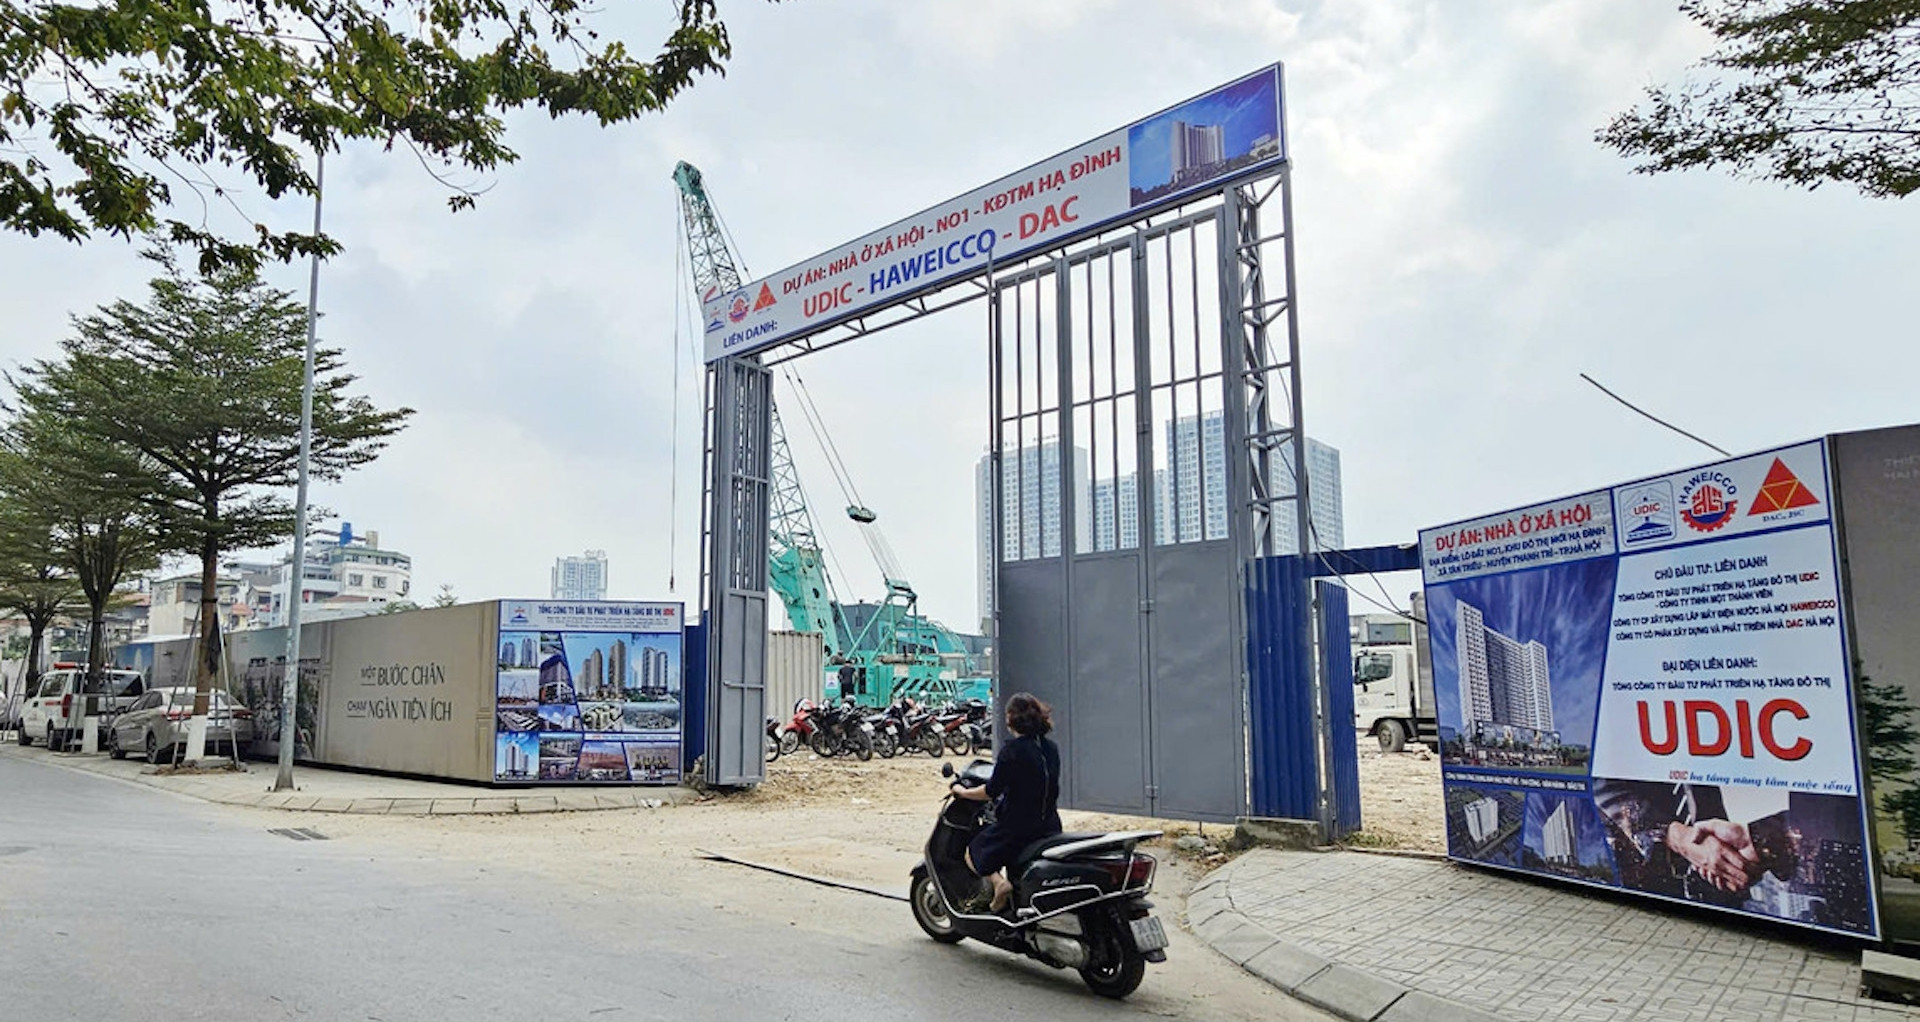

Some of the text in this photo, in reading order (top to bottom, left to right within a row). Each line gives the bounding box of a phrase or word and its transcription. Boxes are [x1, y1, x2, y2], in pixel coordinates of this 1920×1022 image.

[783, 277, 801, 294] DỰ
[804, 269, 826, 286] ÁN:
[829, 248, 858, 276] NHÀ
[861, 244, 872, 263] Ở
[875, 236, 894, 258] XÃ
[897, 226, 925, 248] HỘI
[937, 209, 969, 233] NO1
[984, 181, 1034, 215] KĐTM
[1039, 169, 1066, 193] HẠ
[1069, 146, 1121, 181] ĐÌNH
[804, 282, 852, 318] UDIC
[870, 229, 996, 294] HAWEICCO
[1019, 195, 1079, 240] DAC
[723, 320, 778, 348] LIÊN DANH:
[1679, 471, 1737, 504] HAWEICCO
[1634, 503, 1661, 516] UDIC
[1436, 503, 1592, 553] DỰ ÁN: NHÀ Ở XÃ HỘI
[1655, 566, 1673, 580] CHỦ
[1675, 564, 1694, 578] ĐẦU
[1715, 558, 1737, 573] LIÊN
[1739, 555, 1768, 570] DANH
[1799, 571, 1820, 582] UDIC
[1790, 600, 1836, 612] HAWEICCO
[1785, 618, 1804, 628] DAC
[377, 663, 409, 686] BƯỚC
[412, 662, 445, 686] CHÂN
[1703, 656, 1724, 670] LIÊN
[1726, 657, 1758, 669] DANH:
[368, 696, 398, 719] NGÀN
[431, 697, 452, 721] ÍCH
[1636, 698, 1814, 762] UDIC
[1669, 770, 1689, 781] UDIC
